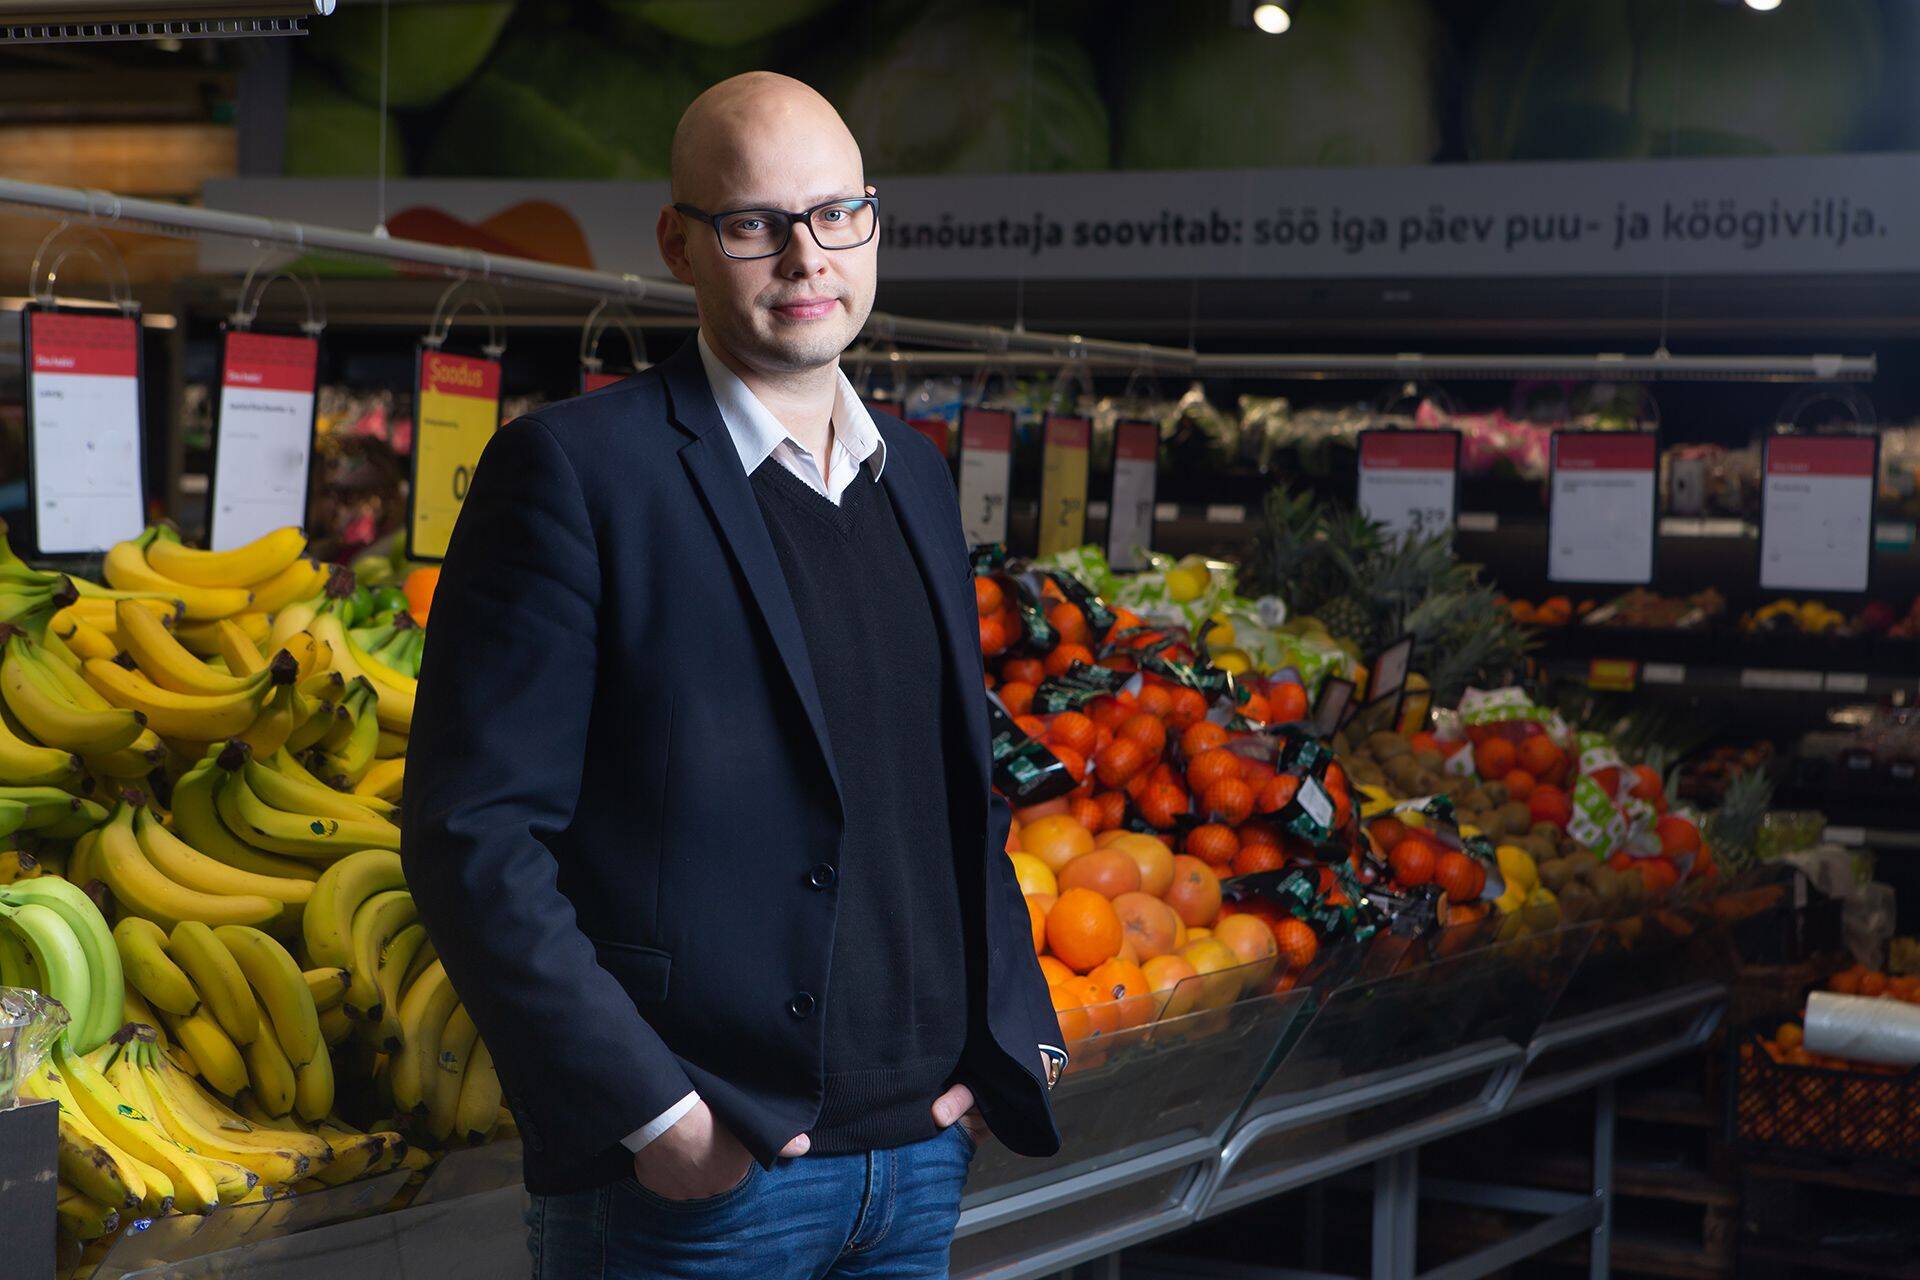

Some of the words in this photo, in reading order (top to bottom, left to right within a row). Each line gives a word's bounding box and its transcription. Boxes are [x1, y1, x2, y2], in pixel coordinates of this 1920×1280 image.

[1073, 207, 1244, 247] soovitab:
[1254, 204, 1320, 246] söö
[1331, 207, 1388, 253] iga
[1400, 206, 1494, 252] päev
[1506, 212, 1600, 253] puu-
[1612, 202, 1651, 251] ja
[1663, 198, 1888, 250] köögivilja.
[429, 357, 484, 388] Soodus
